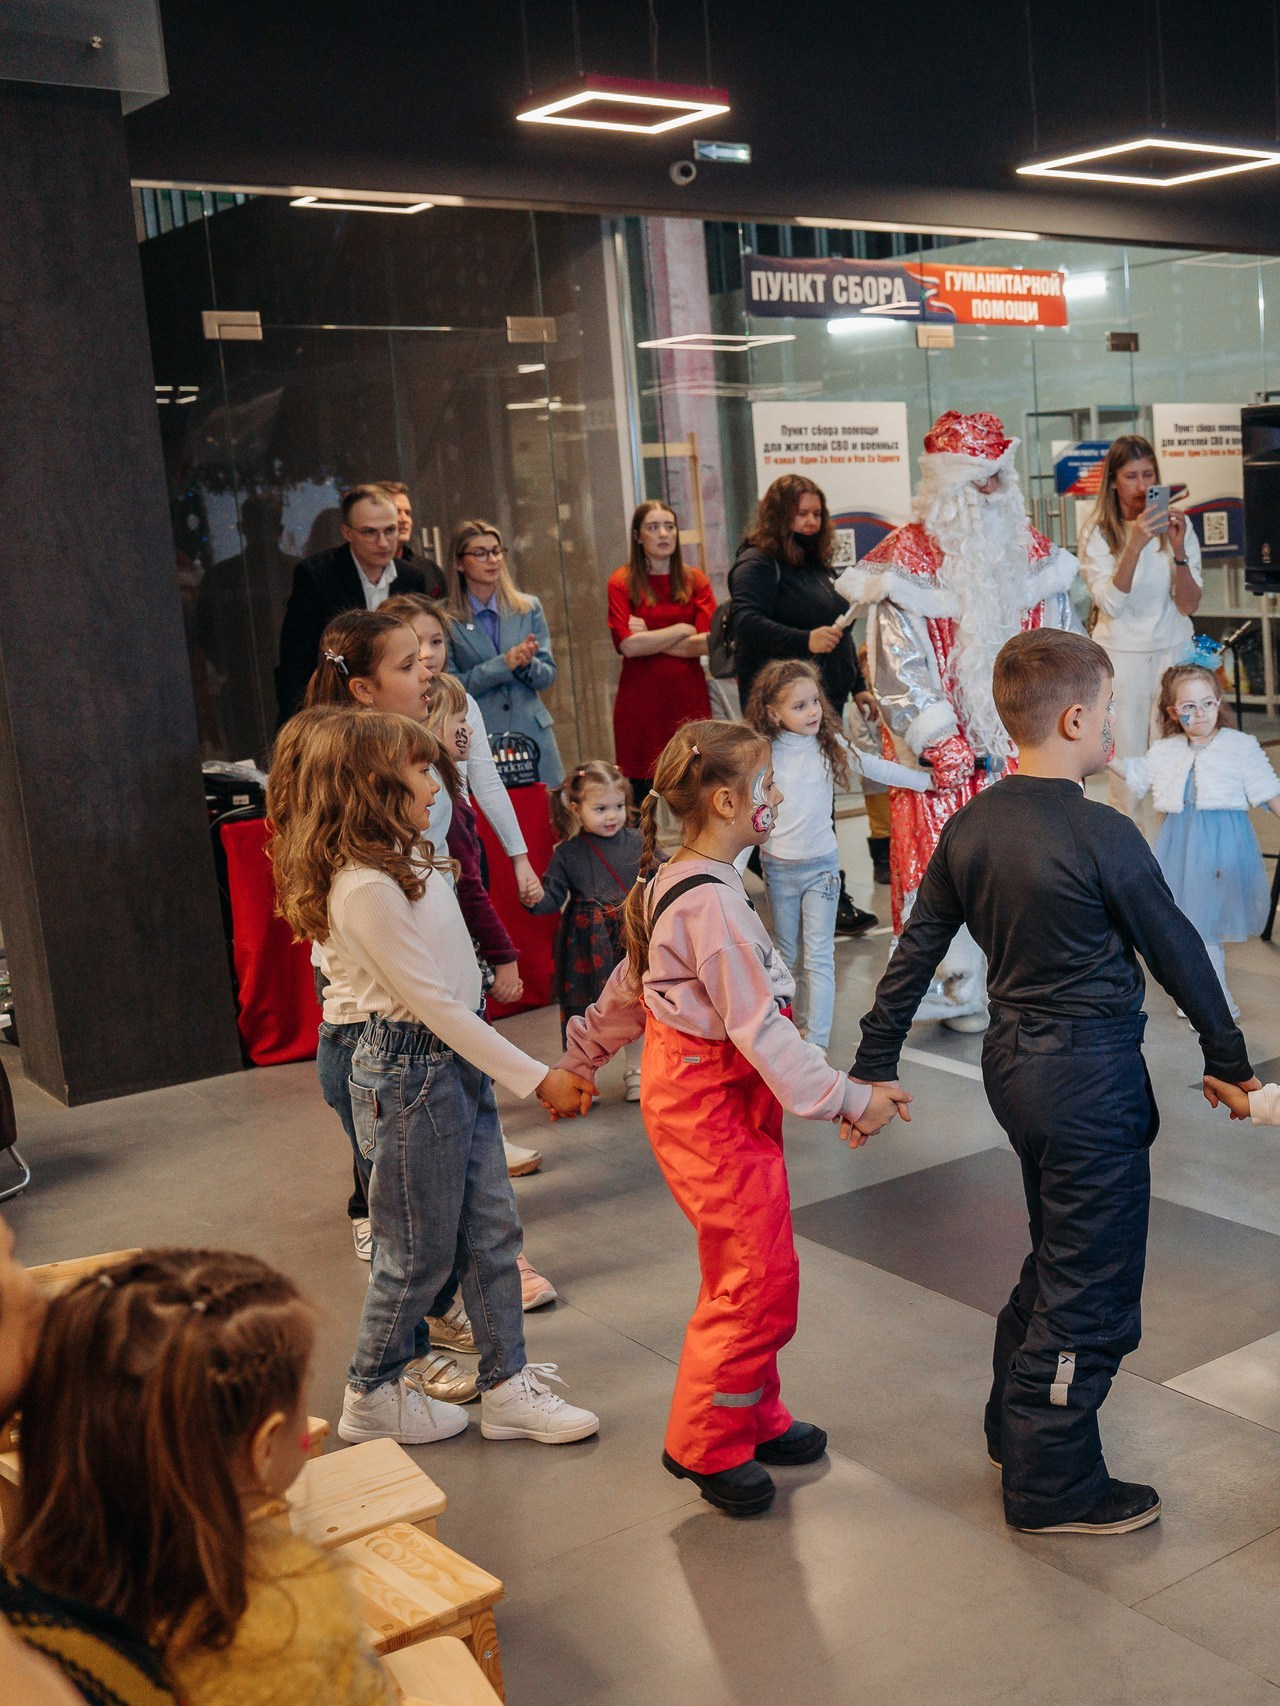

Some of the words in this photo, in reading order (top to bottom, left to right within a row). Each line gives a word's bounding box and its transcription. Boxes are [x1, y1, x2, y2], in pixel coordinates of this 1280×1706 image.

[751, 271, 826, 303] ПУНКТ
[832, 274, 908, 305] СБОРА
[945, 270, 1061, 297] ГУМАНИТАРНОЙ
[971, 299, 1039, 323] ПОМОЩИ
[781, 424, 808, 437] Пункт
[811, 424, 839, 437] сбора
[841, 426, 879, 436] помощи
[1218, 425, 1242, 433] помощ
[764, 443, 782, 453] для
[785, 440, 828, 451] жителей
